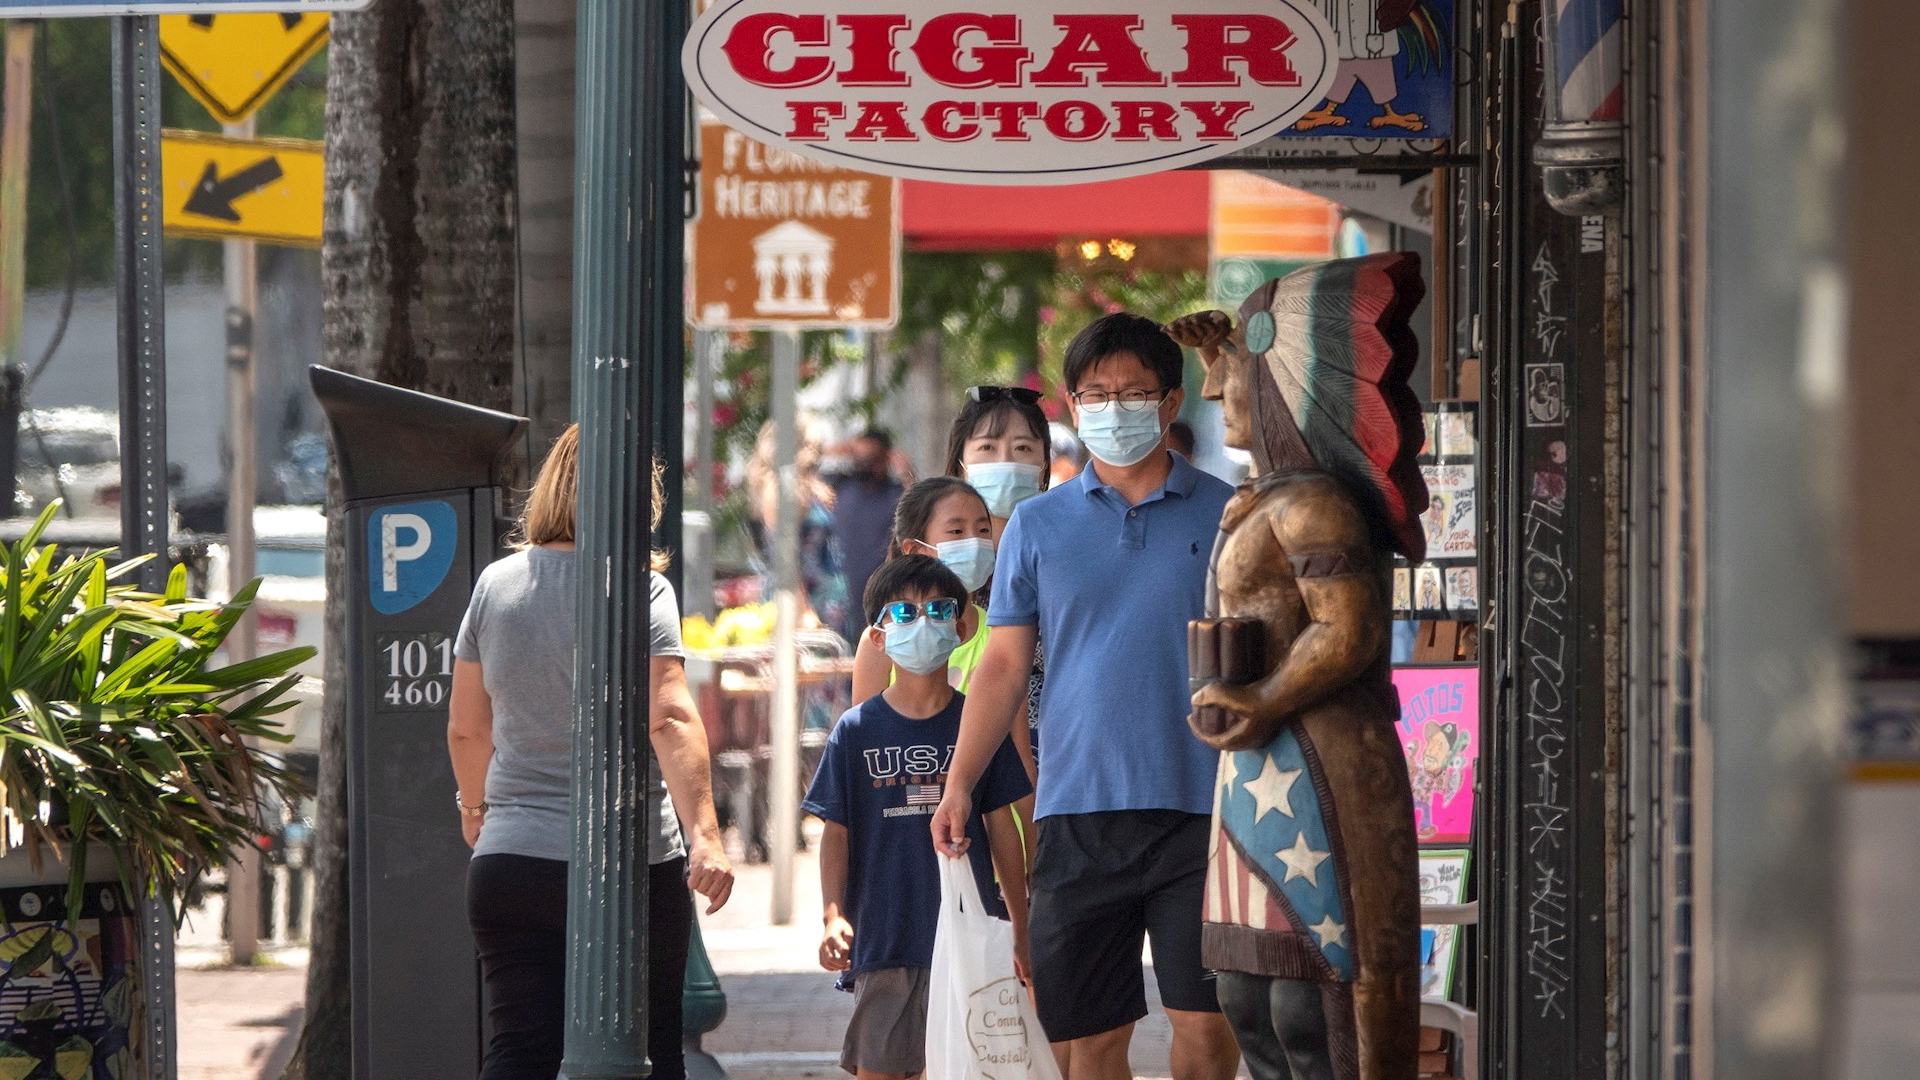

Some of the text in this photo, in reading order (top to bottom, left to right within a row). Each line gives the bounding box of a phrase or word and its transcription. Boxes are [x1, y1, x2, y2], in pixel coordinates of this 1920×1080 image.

[720, 12, 1301, 89] CIGAR
[785, 101, 1255, 143] FACTORY
[714, 174, 872, 219] HERITAGE
[381, 513, 432, 592] P
[383, 637, 452, 677] 101
[384, 680, 443, 705] 460
[1400, 682, 1465, 734] FOTOS
